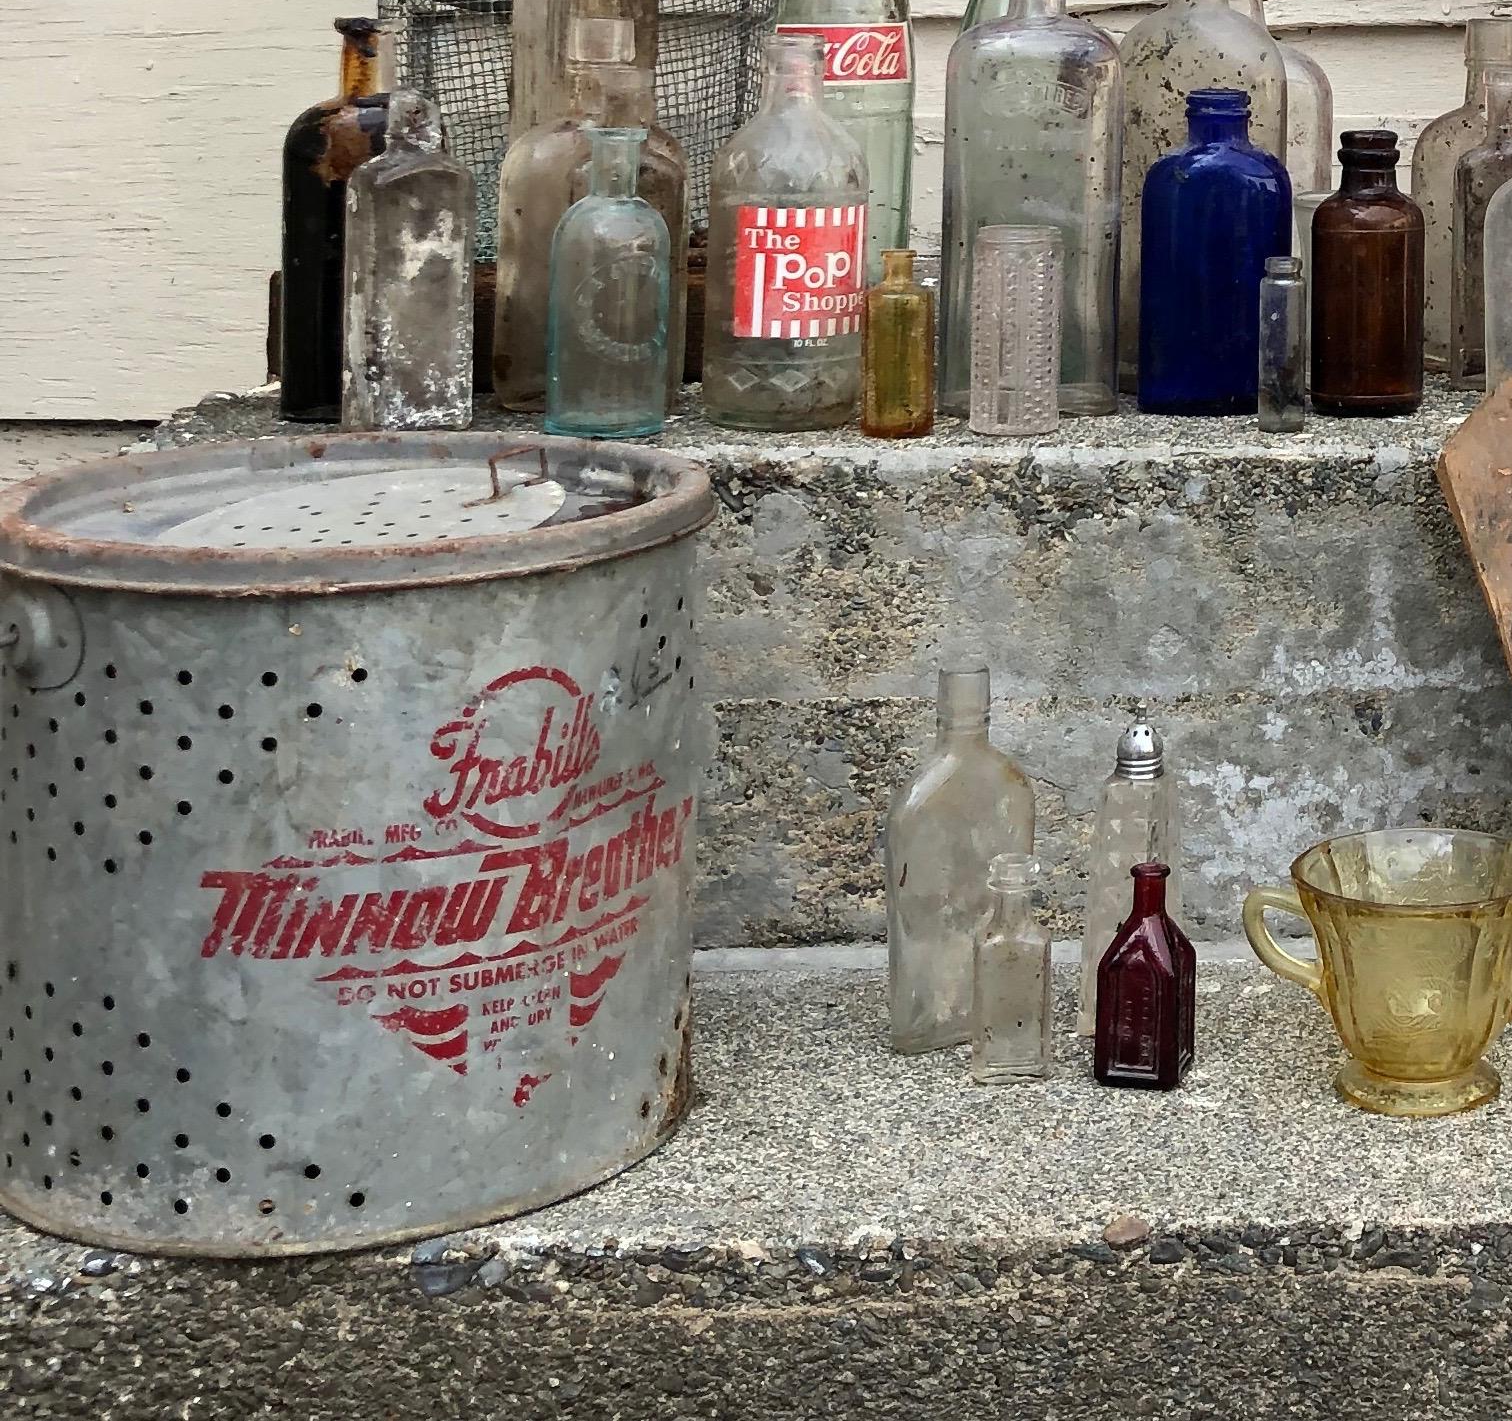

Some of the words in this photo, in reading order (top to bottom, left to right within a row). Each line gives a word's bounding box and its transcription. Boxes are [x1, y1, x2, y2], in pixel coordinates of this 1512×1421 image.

[823, 31, 901, 77] -Cola
[744, 227, 801, 250] The
[770, 251, 852, 290] Pop
[781, 291, 865, 314] Shoppe
[384, 823, 422, 844] MFG
[336, 986, 377, 1006] DO
[387, 976, 441, 1000] NOT
[449, 950, 565, 994] SUBMERGE
